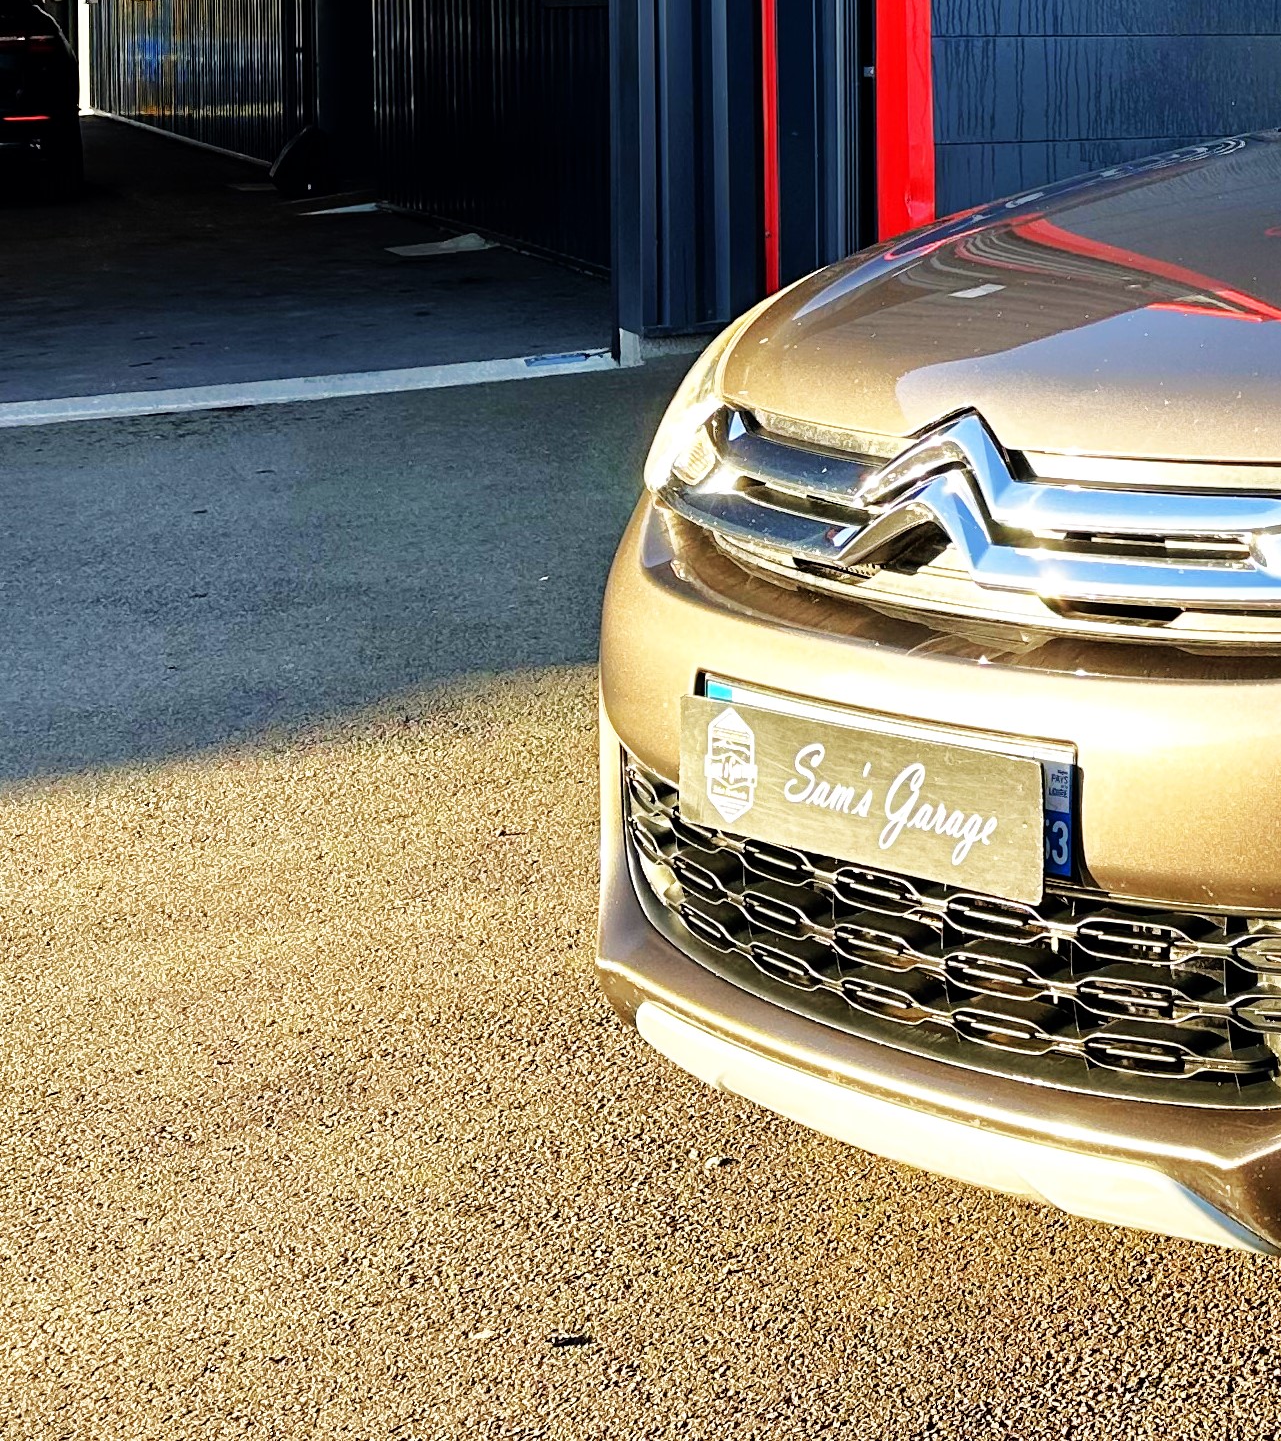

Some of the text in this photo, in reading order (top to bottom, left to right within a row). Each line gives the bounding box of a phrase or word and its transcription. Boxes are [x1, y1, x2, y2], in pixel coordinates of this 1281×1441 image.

[784, 742, 998, 866] Sam's Garage
[1045, 819, 1069, 866] 3
